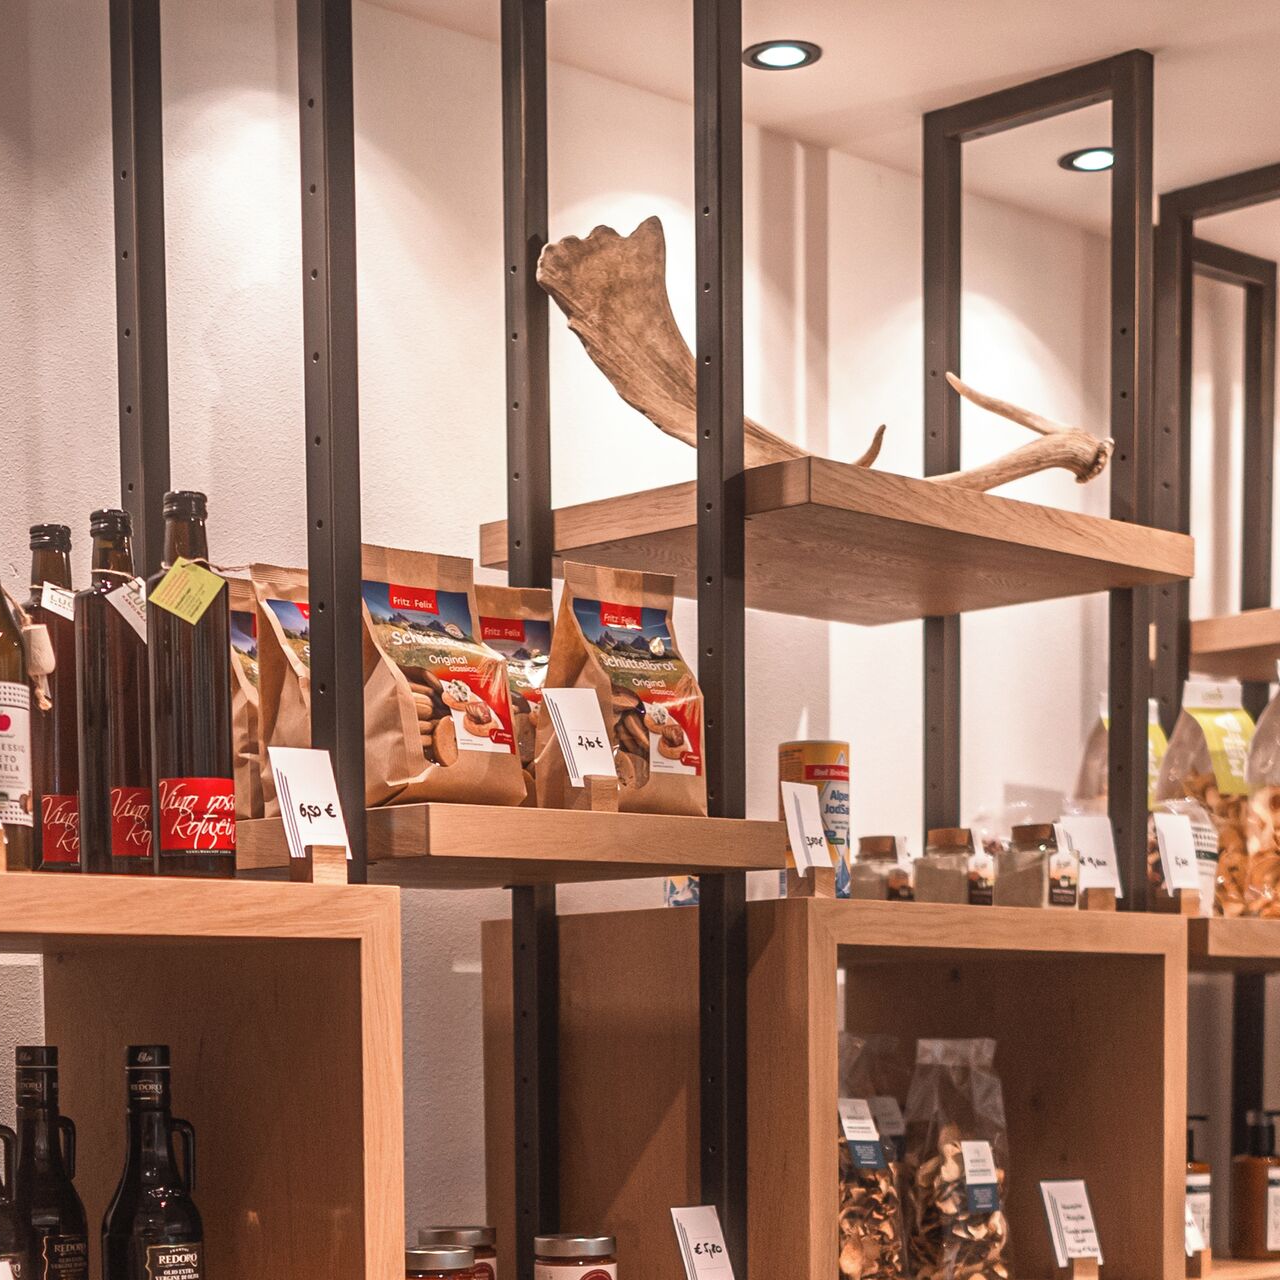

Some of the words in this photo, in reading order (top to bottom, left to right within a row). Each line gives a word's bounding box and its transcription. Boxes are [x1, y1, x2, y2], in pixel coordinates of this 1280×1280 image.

[393, 596, 411, 607] Fritz
[414, 598, 433, 610] Felix
[604, 613, 619, 624] Fritz
[484, 627, 501, 637] Fritz
[504, 628, 521, 638] Felix
[429, 655, 468, 666] Original
[600, 654, 678, 672] Schüttelbrot
[632, 678, 667, 688] Original
[111, 788, 151, 824] Vino
[158, 780, 199, 821] Vino
[158, 1251, 198, 1267] REDORO
